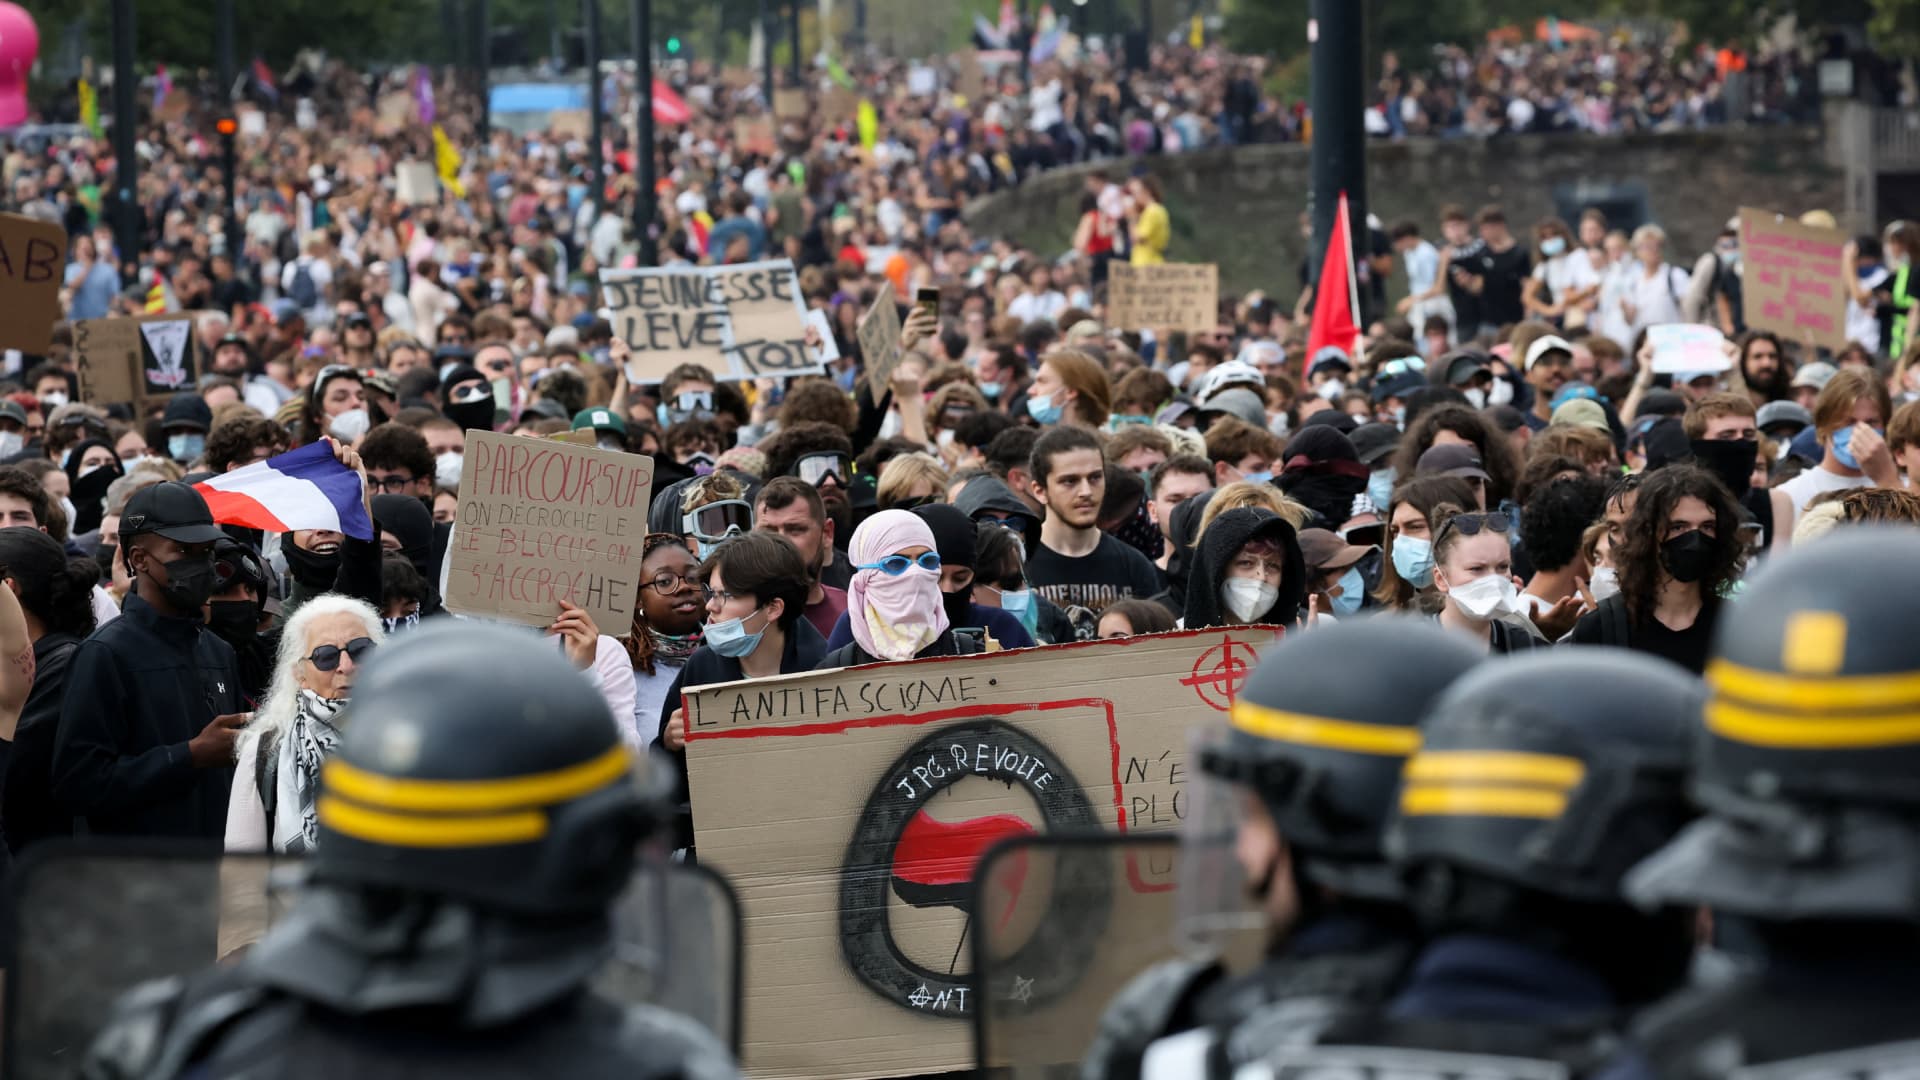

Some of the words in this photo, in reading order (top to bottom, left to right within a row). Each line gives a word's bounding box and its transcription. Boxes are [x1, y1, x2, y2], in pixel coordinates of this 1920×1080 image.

[602, 268, 793, 311] JEUNESSE
[626, 311, 730, 351] LEVE
[720, 339, 817, 375] TOI
[473, 440, 651, 508] PARCOURSUP
[464, 501, 491, 527] ON
[498, 501, 598, 531] DÉCROCHE
[605, 517, 628, 537] LE
[461, 528, 482, 551] LE
[496, 528, 597, 563] BLOCUS
[607, 544, 631, 565] ON
[471, 563, 628, 613] S'ACCROCHE
[694, 676, 978, 727] L'ANTIFASCISME
[1126, 750, 1188, 784] N'E
[1133, 790, 1190, 826] PLU
